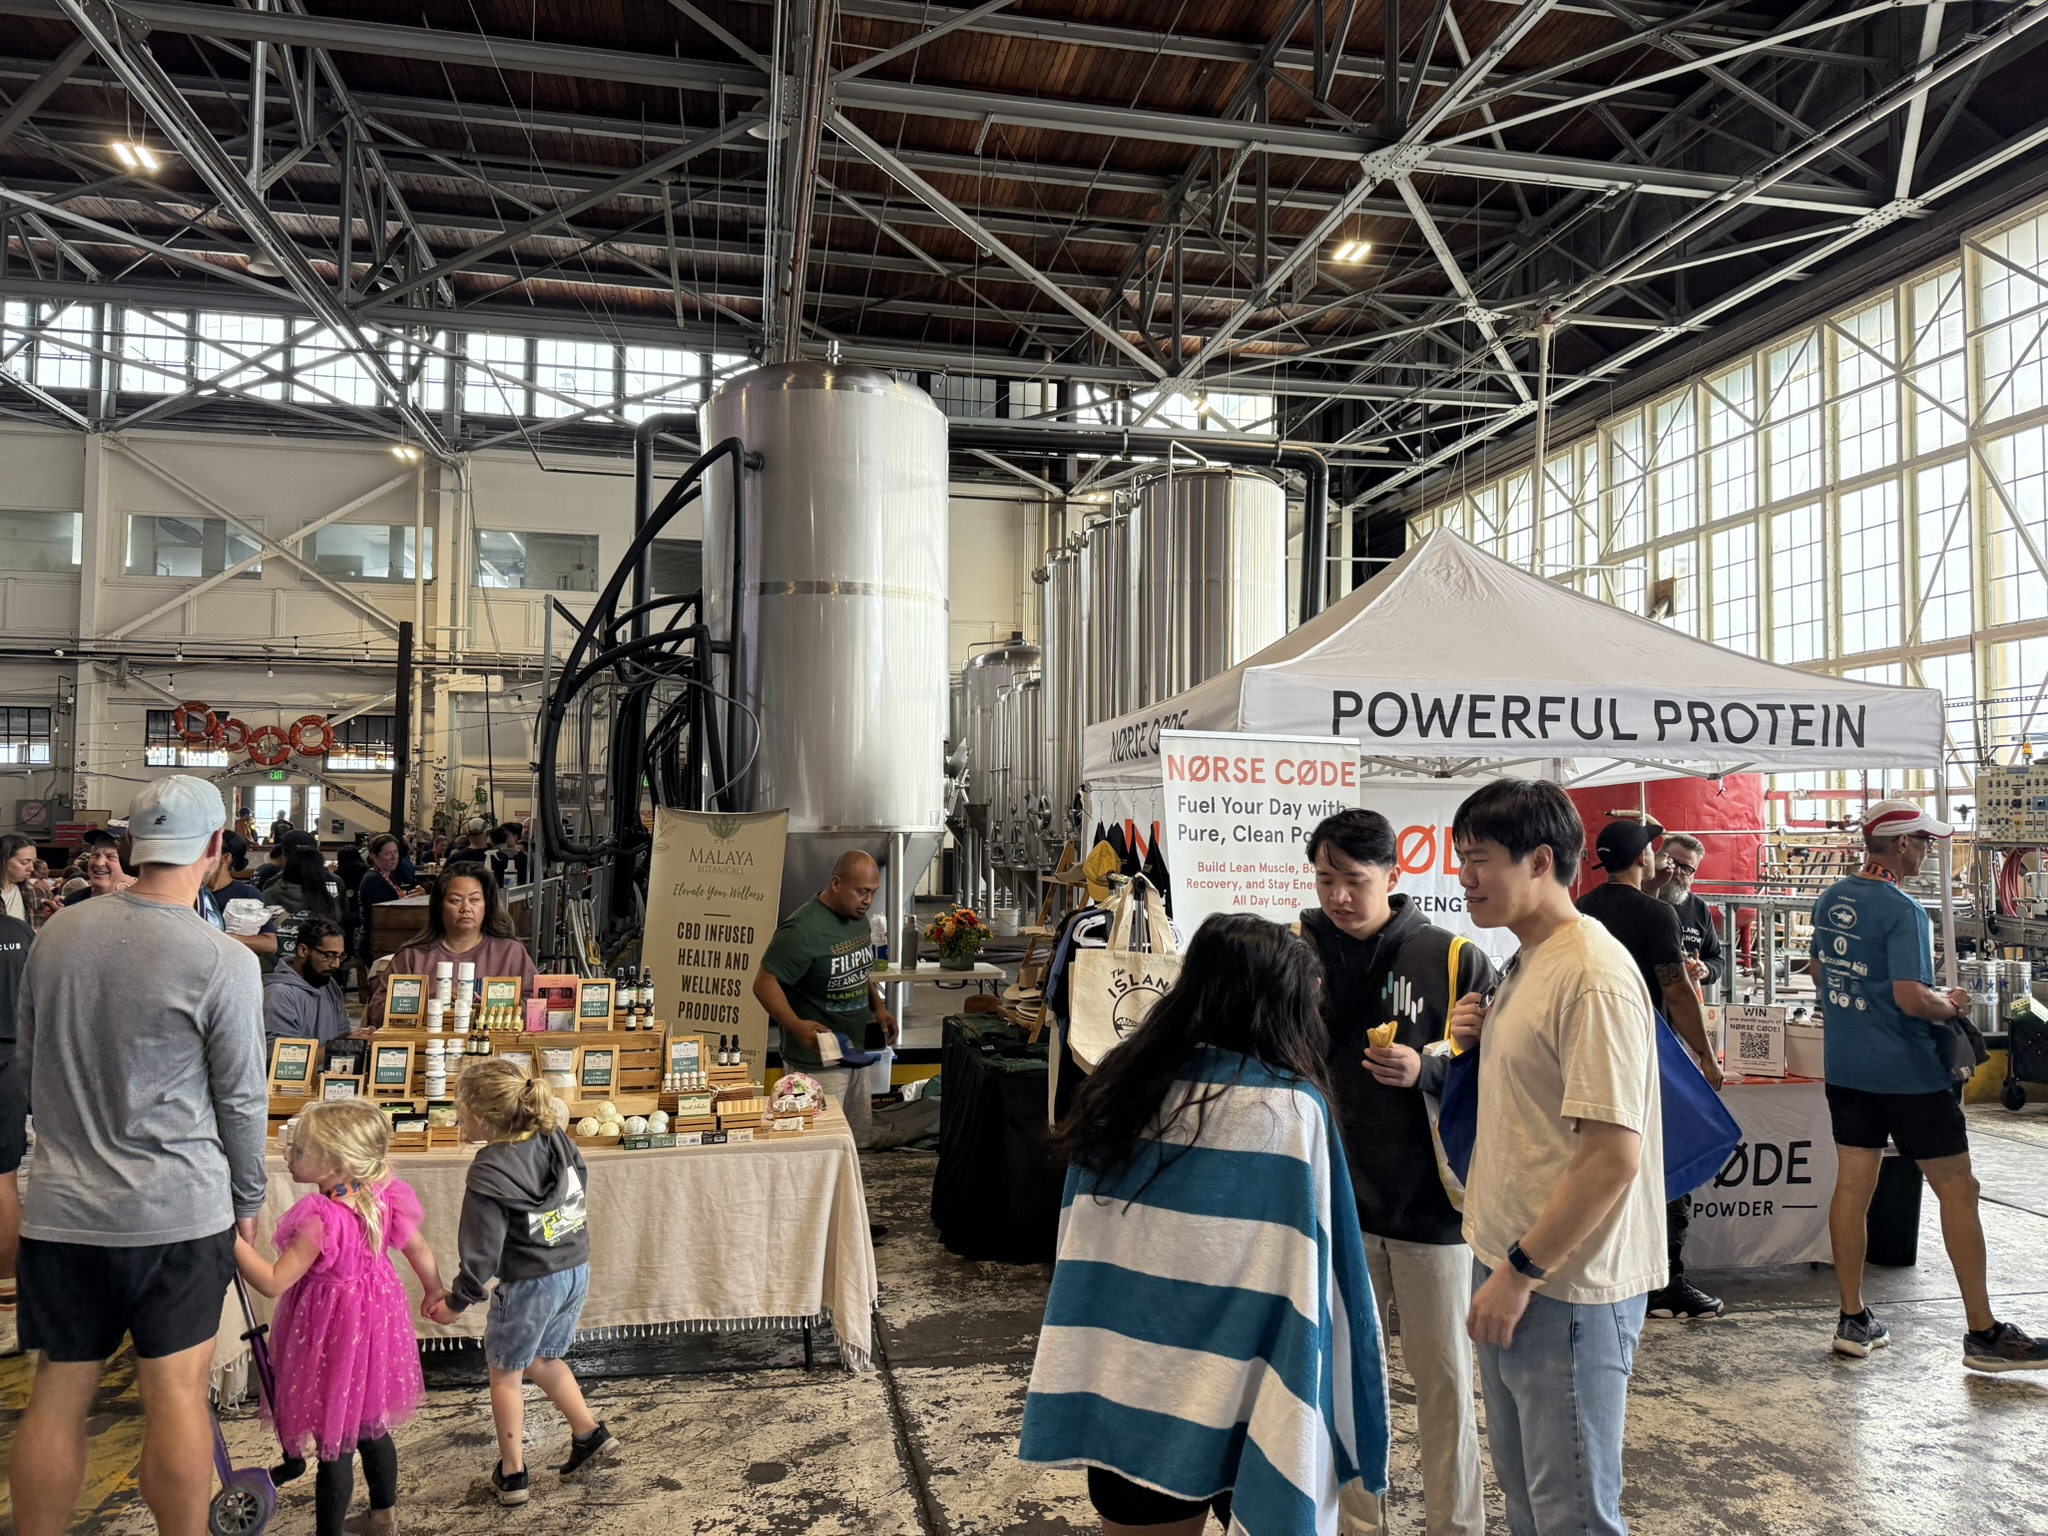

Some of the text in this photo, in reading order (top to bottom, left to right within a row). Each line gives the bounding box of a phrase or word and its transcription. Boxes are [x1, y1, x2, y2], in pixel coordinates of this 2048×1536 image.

[1332, 689, 1866, 749] POWERFUL PROTEIN
[1109, 720, 1148, 764] NØRSE
[269, 770, 283, 780] EXIT
[1167, 754, 1357, 788] NØRSE CØDE
[1177, 795, 1346, 820] Fuel Your Day with
[1177, 823, 1227, 846] Pure,
[1232, 824, 1285, 845] Clean
[688, 847, 755, 867] MALAYA
[697, 866, 745, 876] BOTANICALS
[1197, 862, 1227, 874] Build
[1229, 862, 1256, 874] Lean
[1259, 862, 1299, 876] Muscle,
[672, 883, 766, 902] Elevate Your Wellness
[1186, 878, 1242, 892] Recovery,
[1245, 878, 1266, 890] and
[1268, 879, 1291, 892] Stay
[1232, 895, 1301, 909] All Day Long.
[677, 921, 755, 945] CBD INFUSED
[677, 947, 750, 971] HEALTH AND
[830, 944, 874, 976] FILIPIN
[1110, 967, 1127, 979] The
[681, 973, 742, 998] WELLNESS
[1107, 973, 1170, 999] ISLAN
[677, 1001, 740, 1025] PRODUCTS
[1743, 1007, 1767, 1017] WIN
[1713, 1140, 1812, 1189] ØDE
[1693, 1200, 1774, 1218] POWDER
